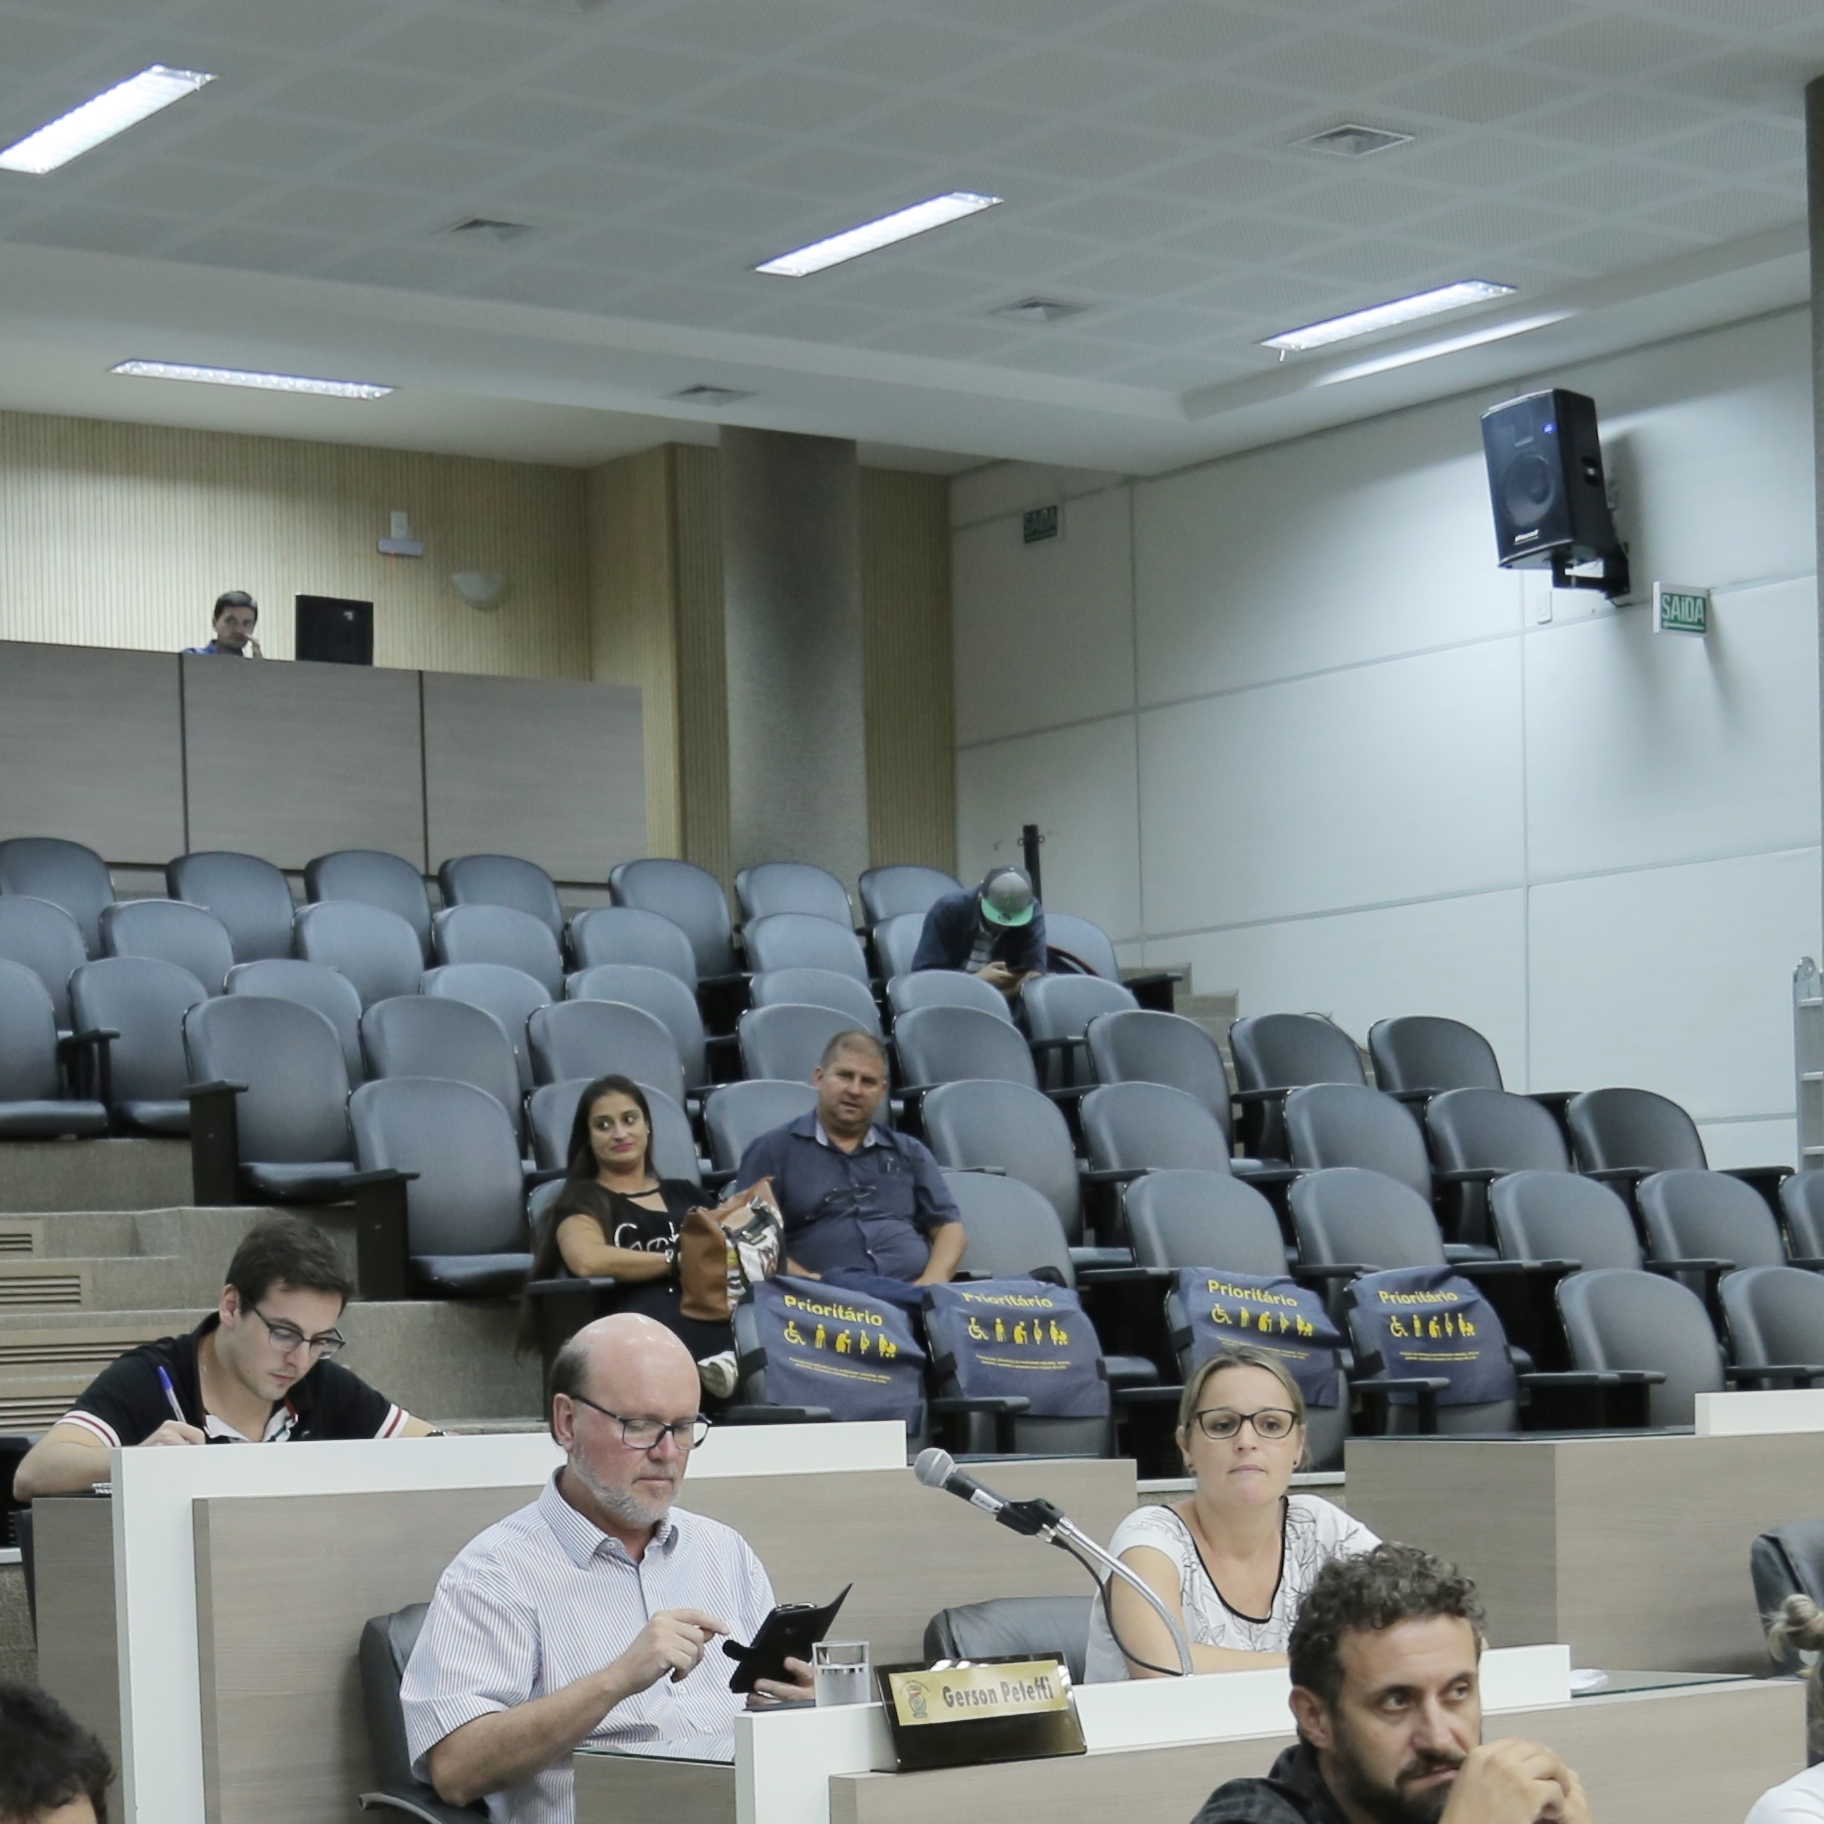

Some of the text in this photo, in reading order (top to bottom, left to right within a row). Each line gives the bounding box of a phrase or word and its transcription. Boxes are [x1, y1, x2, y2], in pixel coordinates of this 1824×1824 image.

[1661, 593, 1706, 623] SAÍDA
[961, 1292, 1054, 1308] Prioritário
[1207, 1278, 1299, 1307] Prioritário
[1377, 1289, 1460, 1305] Prioritário
[783, 1294, 884, 1327] Prioritário
[942, 1684, 999, 1709] Gerson
[1001, 1675, 1055, 1704] Peteffi
